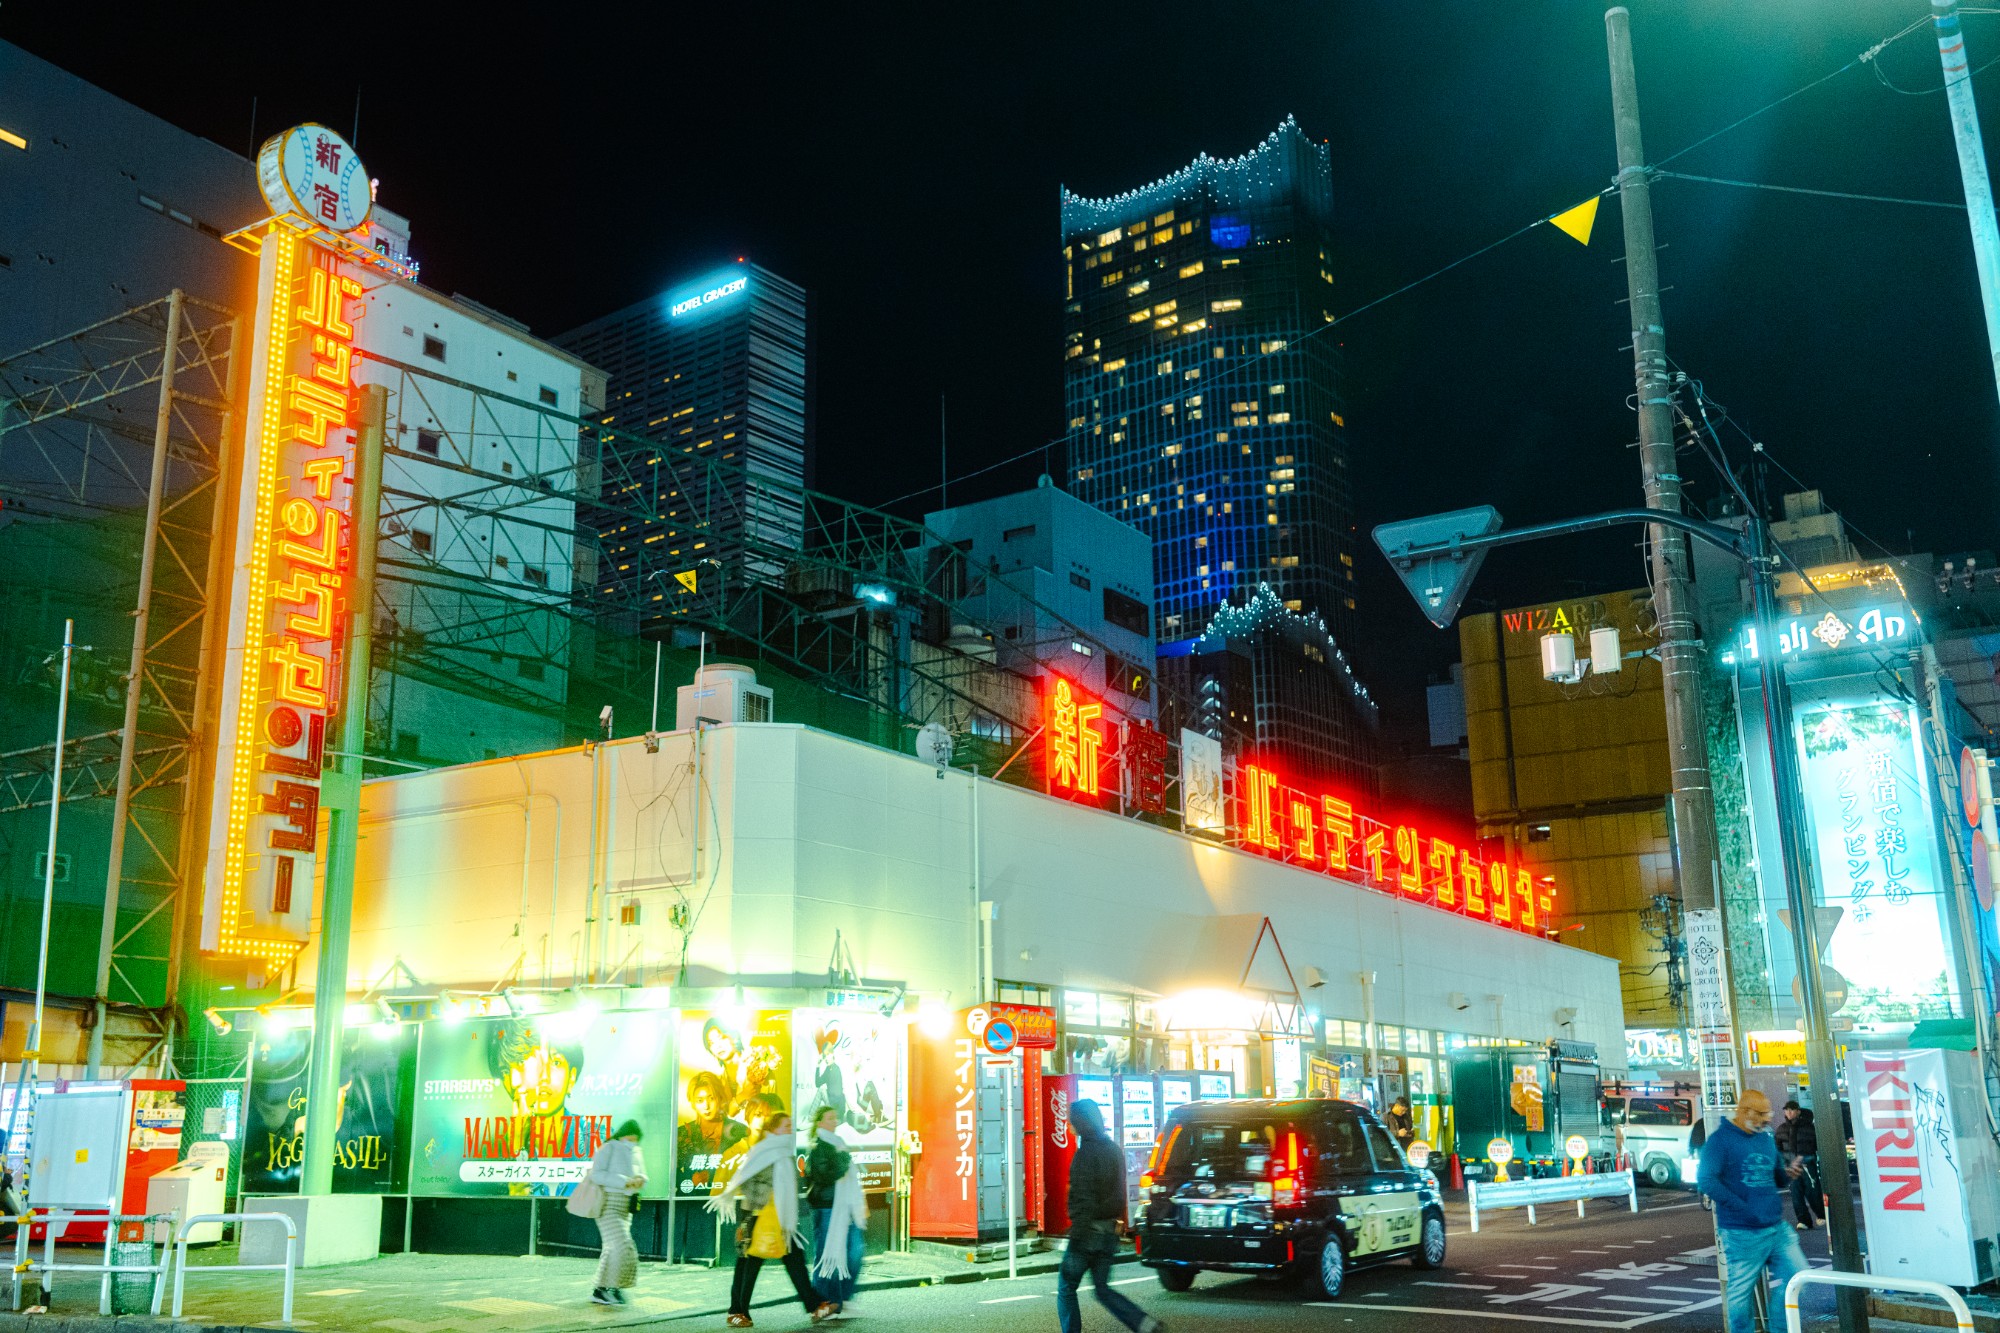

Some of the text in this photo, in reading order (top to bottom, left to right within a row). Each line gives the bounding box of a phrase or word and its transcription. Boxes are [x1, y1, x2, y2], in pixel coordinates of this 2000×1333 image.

[314, 133, 342, 222] 新宿
[672, 277, 747, 316] HOTEL GRACERY
[257, 267, 362, 914] バッティングセンター
[1504, 600, 1608, 633] WIZARD
[1052, 677, 1552, 928] 新宿 バッティングセンター
[1866, 750, 1912, 906] 新宿で楽しむ
[1688, 924, 1718, 934] HOTEL
[424, 1079, 494, 1095] STARGUYS
[463, 1115, 612, 1159] MARU HAZUKI
[955, 1038, 975, 1201] コインロッカー
[1051, 1087, 1067, 1149] Coca-Cola
[1864, 1060, 1926, 1212] KIRIN
[265, 1132, 387, 1173] YGGASILL
[478, 1166, 584, 1178] スターガイズ フェローズ
